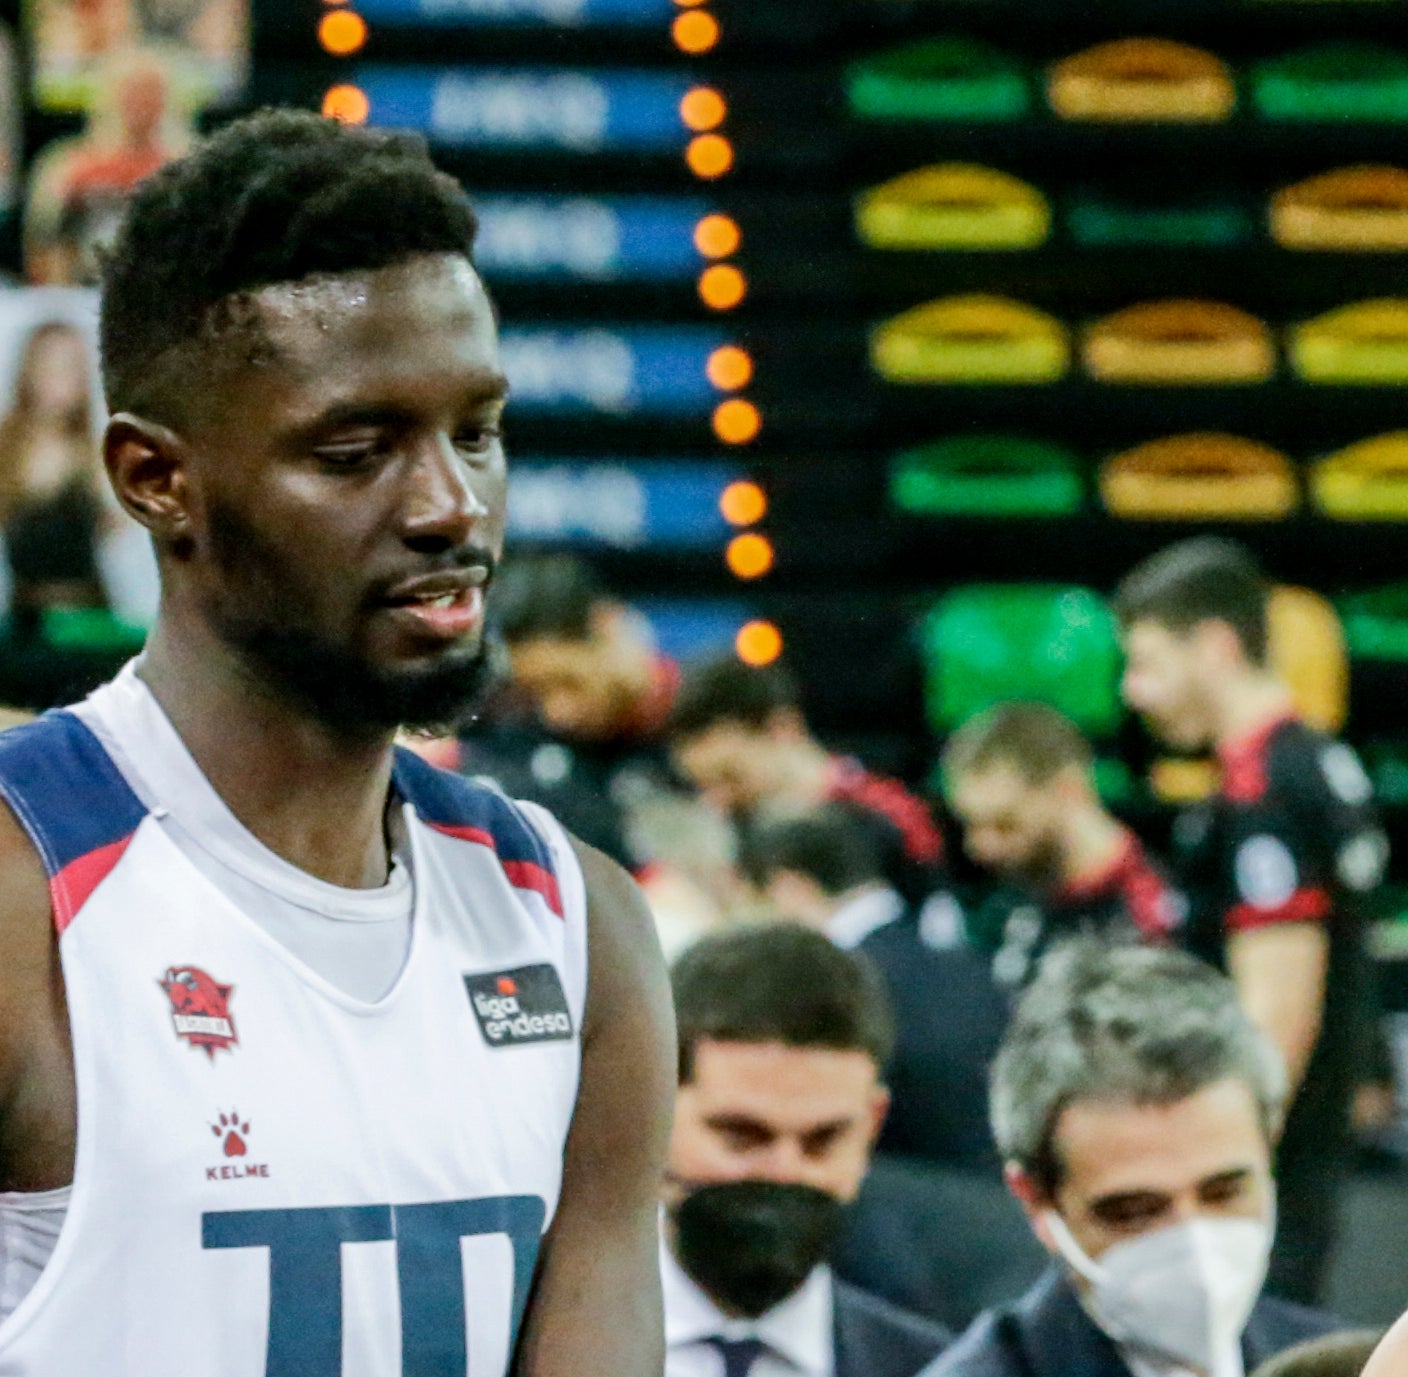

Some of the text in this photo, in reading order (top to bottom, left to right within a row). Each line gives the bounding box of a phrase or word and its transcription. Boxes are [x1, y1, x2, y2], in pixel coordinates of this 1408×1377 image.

[473, 993, 520, 1020] liga
[485, 1011, 570, 1039] endesa
[205, 1163, 270, 1181] KELME
